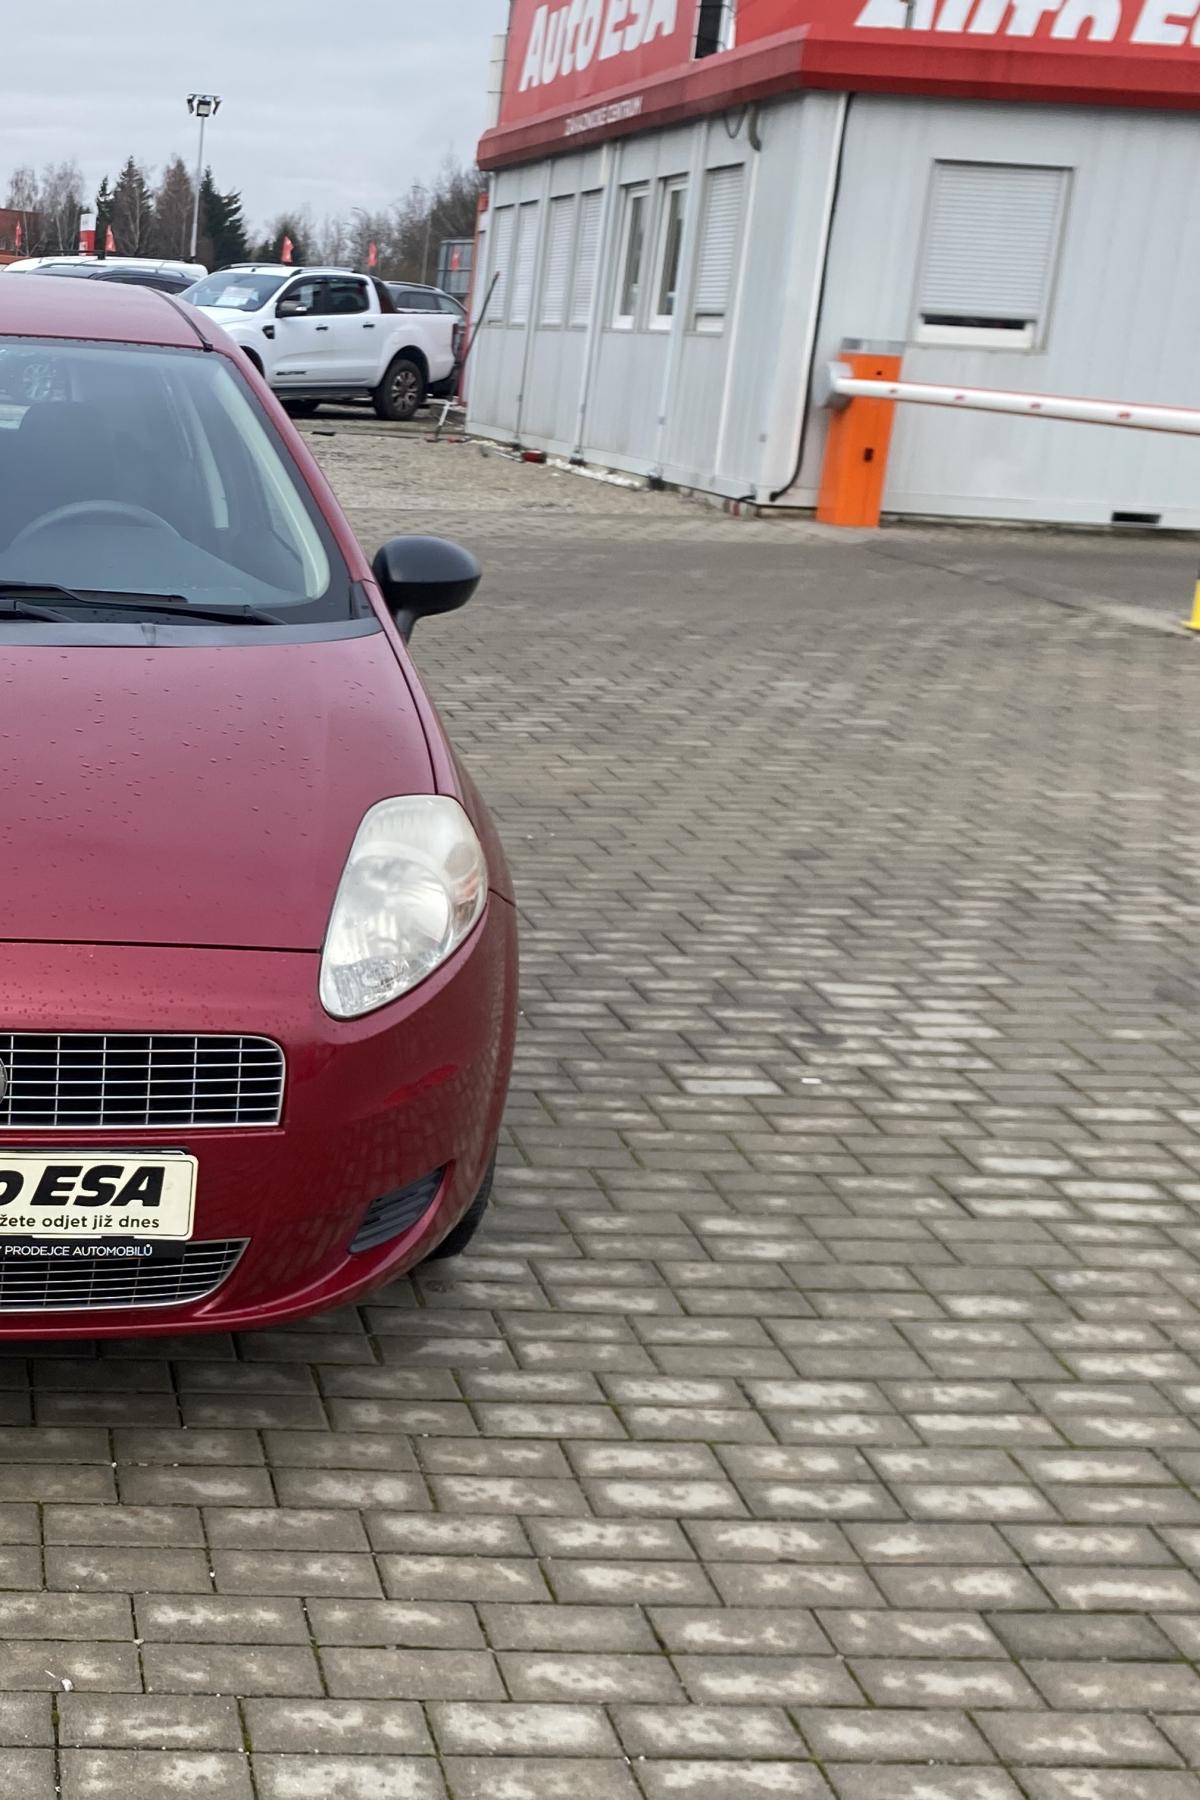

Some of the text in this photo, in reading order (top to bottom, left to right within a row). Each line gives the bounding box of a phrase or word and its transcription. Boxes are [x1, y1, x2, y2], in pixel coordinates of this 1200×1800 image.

[518, 0, 601, 92] Auto
[30, 1165, 165, 1207] ESA
[42, 1215, 88, 1230] odjet
[92, 1214, 113, 1230] již
[118, 1216, 160, 1228] dnes
[4, 1246, 70, 1256] PRODEJCE
[72, 1243, 153, 1257] AUTOMOBILŮ
